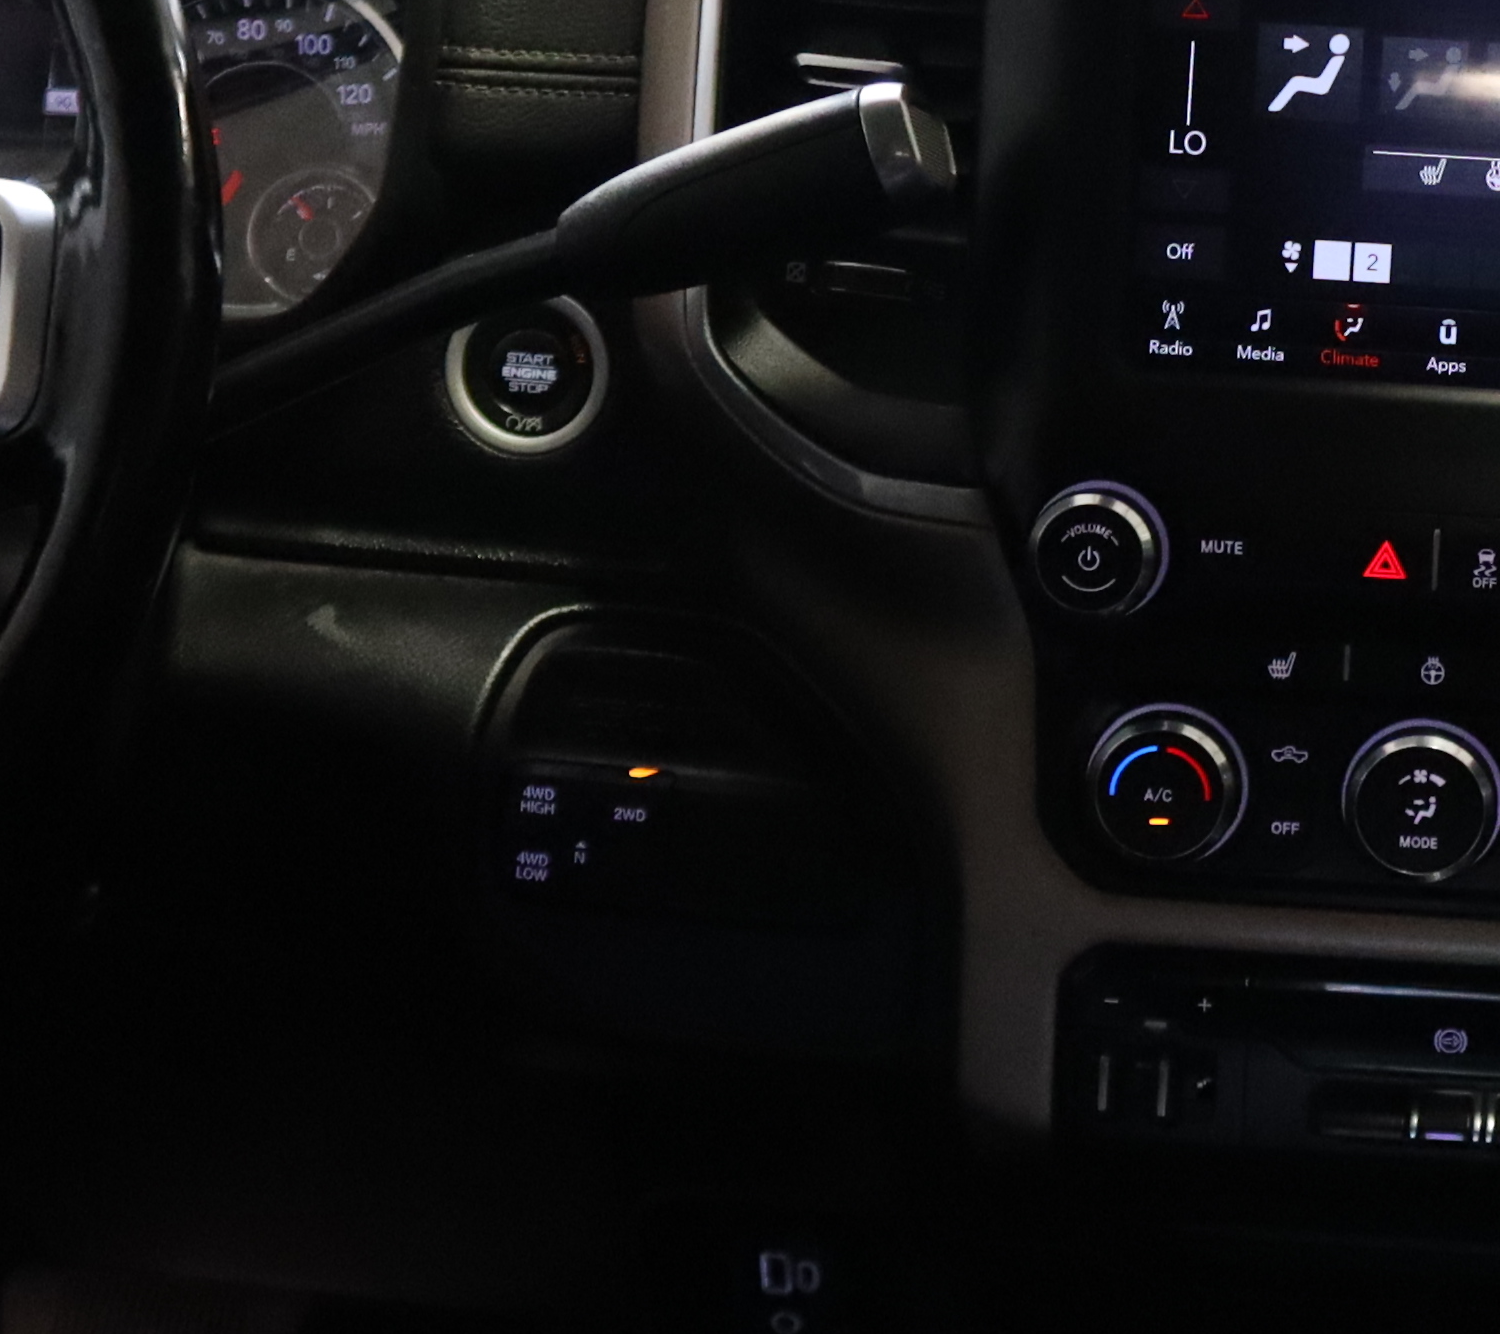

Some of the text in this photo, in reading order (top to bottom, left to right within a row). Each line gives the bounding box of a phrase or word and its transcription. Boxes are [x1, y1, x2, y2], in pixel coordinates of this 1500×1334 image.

[236, 19, 266, 41] 80
[274, 18, 294, 34] 90
[206, 30, 226, 46] 70
[295, 34, 333, 56] 100
[336, 83, 374, 105] 120
[1168, 129, 1208, 156] LO
[1166, 242, 1196, 261] Off
[1365, 253, 1379, 272] 2
[1148, 339, 1194, 357] Radio
[1236, 344, 1285, 363] Media
[506, 351, 554, 365] START
[1319, 349, 1380, 368] Climate
[1426, 356, 1467, 375] Apps
[501, 365, 557, 381] ENGINE
[508, 381, 549, 394] STOP
[1066, 523, 1113, 540] VOLUME
[1200, 539, 1244, 555] MUTE
[1472, 576, 1498, 589] OFF
[522, 785, 555, 801] 4WD
[1143, 788, 1173, 803] A/C
[519, 800, 555, 815] HIGH
[613, 806, 646, 822] 2WD
[1271, 821, 1301, 836] OFF
[1399, 835, 1439, 850] MODE
[516, 851, 549, 867] 4WD
[573, 850, 586, 864] N
[515, 866, 548, 882] LOW
